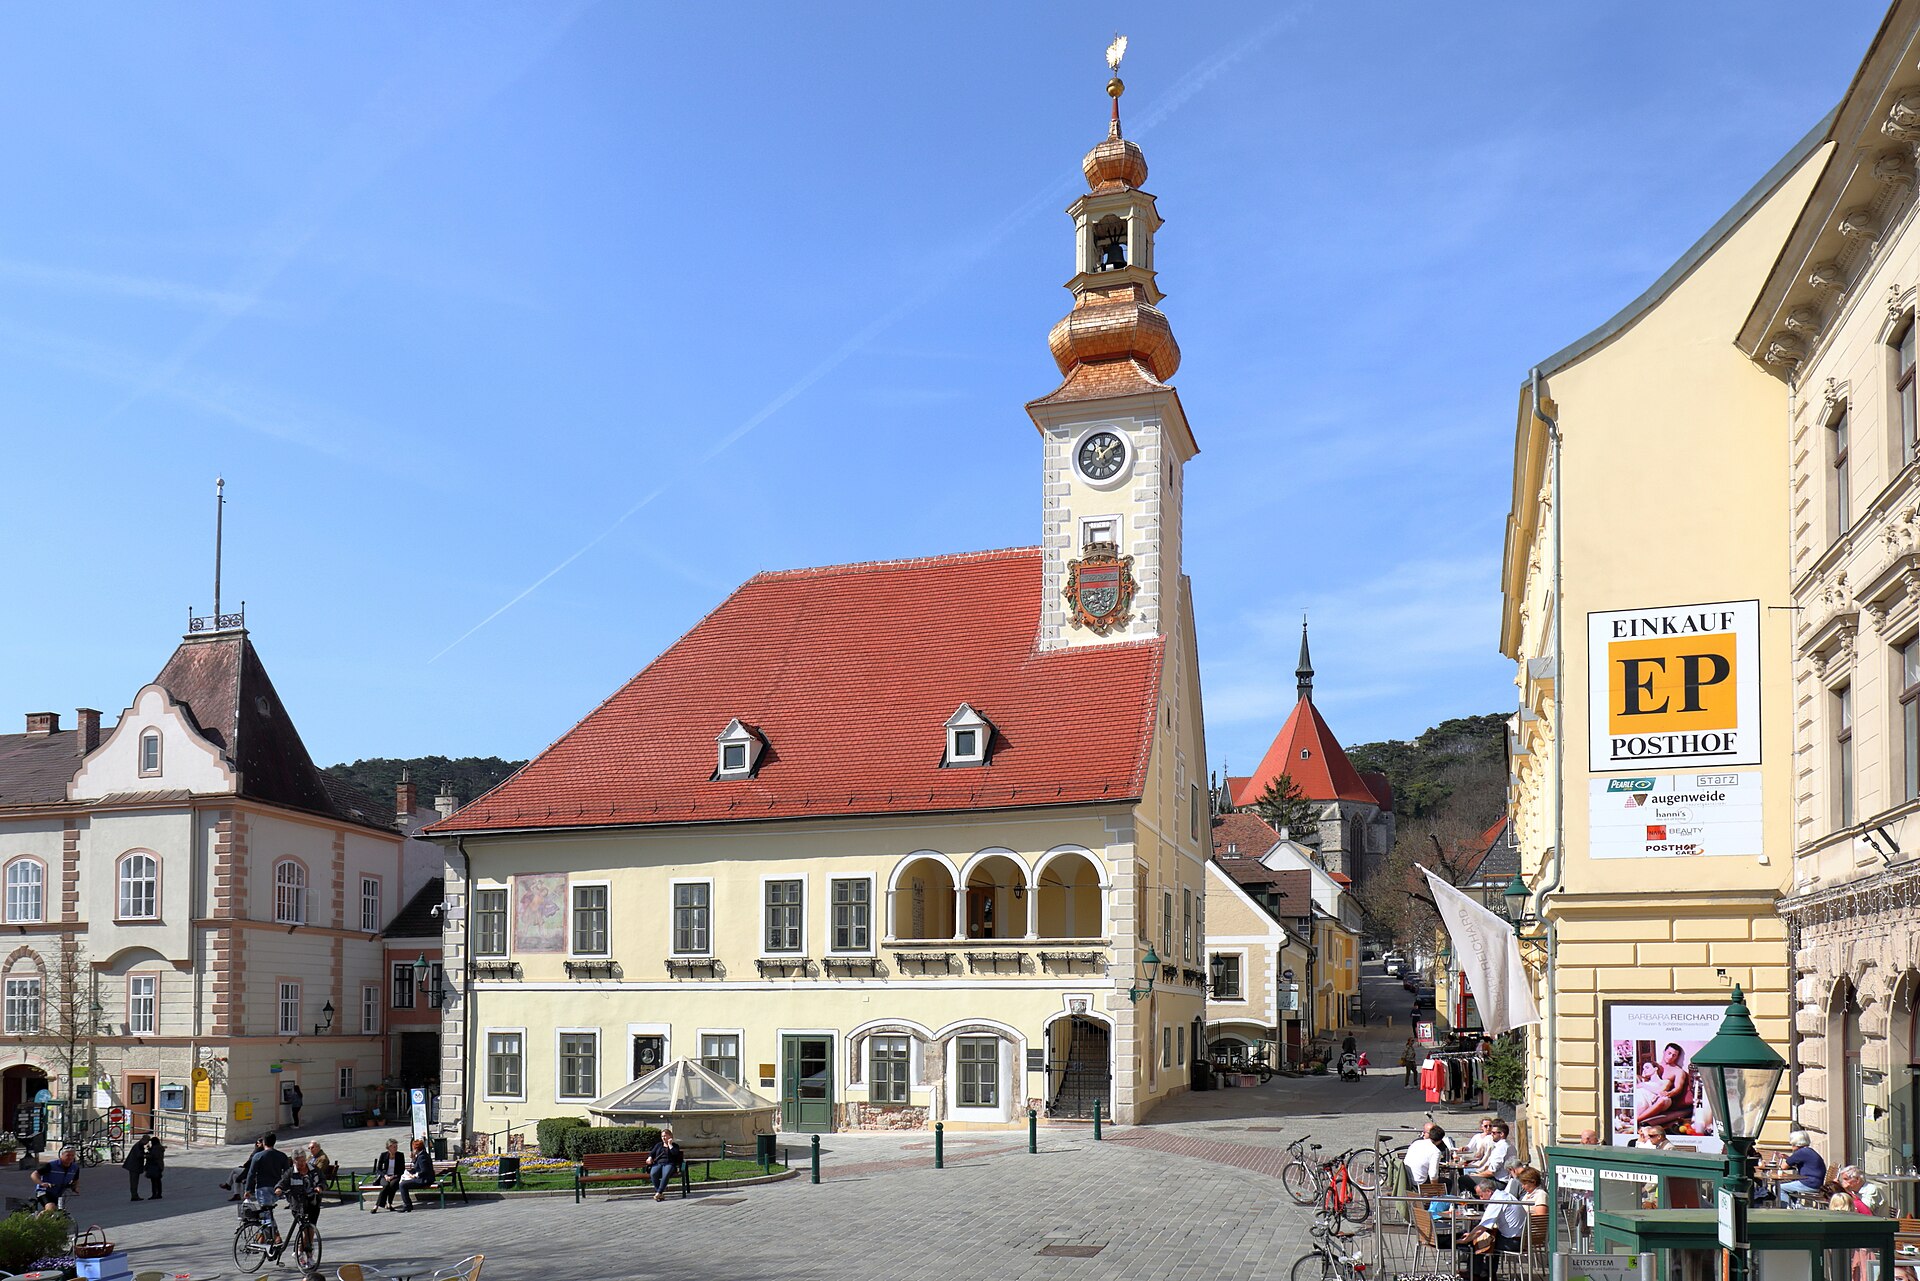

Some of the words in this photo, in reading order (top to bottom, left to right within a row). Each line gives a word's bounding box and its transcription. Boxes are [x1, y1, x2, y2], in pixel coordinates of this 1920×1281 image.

[1612, 612, 1735, 638] EINKAUF
[1616, 653, 1730, 716] EP
[1610, 732, 1737, 757] POSTHOF
[1651, 790, 1726, 806] augenweide
[1656, 808, 1686, 818] hanni's
[1645, 844, 1697, 852] POSTHOF
[1628, 1013, 1670, 1021] BARBARA
[1670, 1013, 1720, 1021] REICHARD
[1604, 1171, 1655, 1182] POSTHOF
